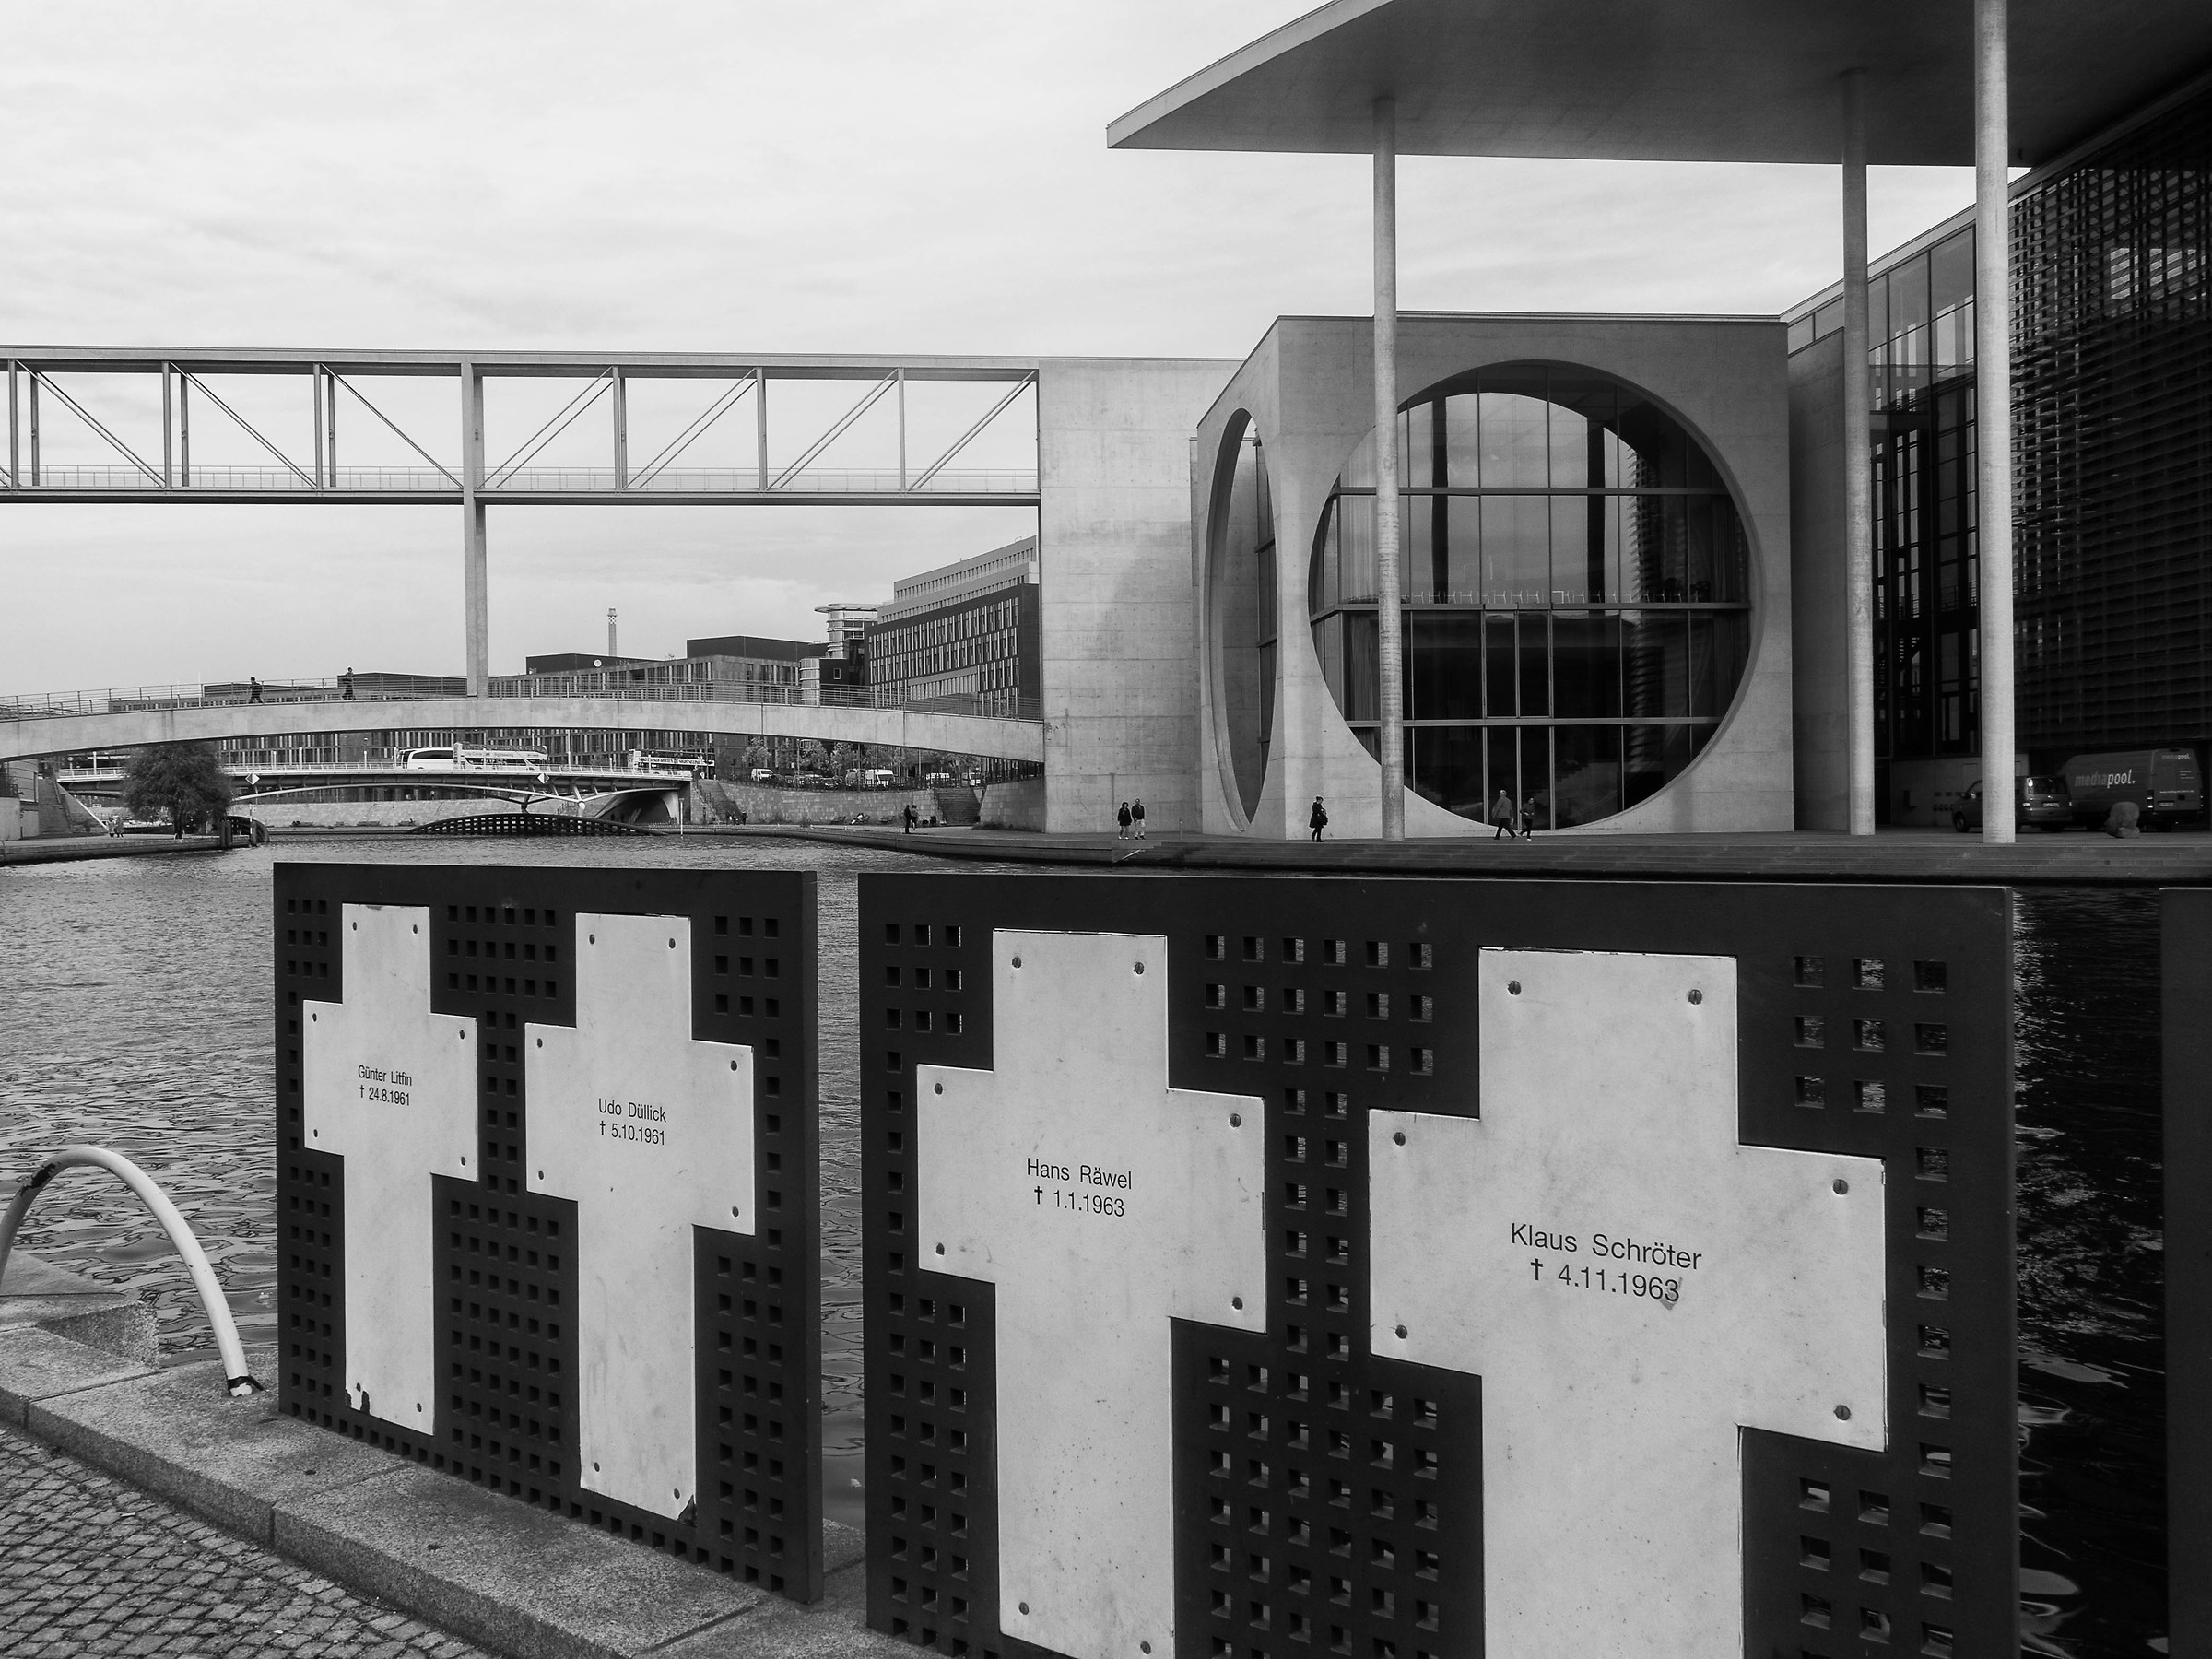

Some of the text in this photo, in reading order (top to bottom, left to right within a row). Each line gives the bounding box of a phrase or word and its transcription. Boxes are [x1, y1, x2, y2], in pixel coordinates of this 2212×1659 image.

[358, 1065, 412, 1086] Günter Litfin
[368, 1087, 410, 1106] 24.8.1961
[598, 1098, 667, 1123] Udo Düllick
[611, 1123, 665, 1146] 5.10.1961
[1027, 1157, 1132, 1190] Hans Räwel
[1053, 1189, 1124, 1218] 1.1.1963
[1512, 1222, 1702, 1270] Klaus Schröter
[1558, 1264, 1680, 1302] 4.11.1963
